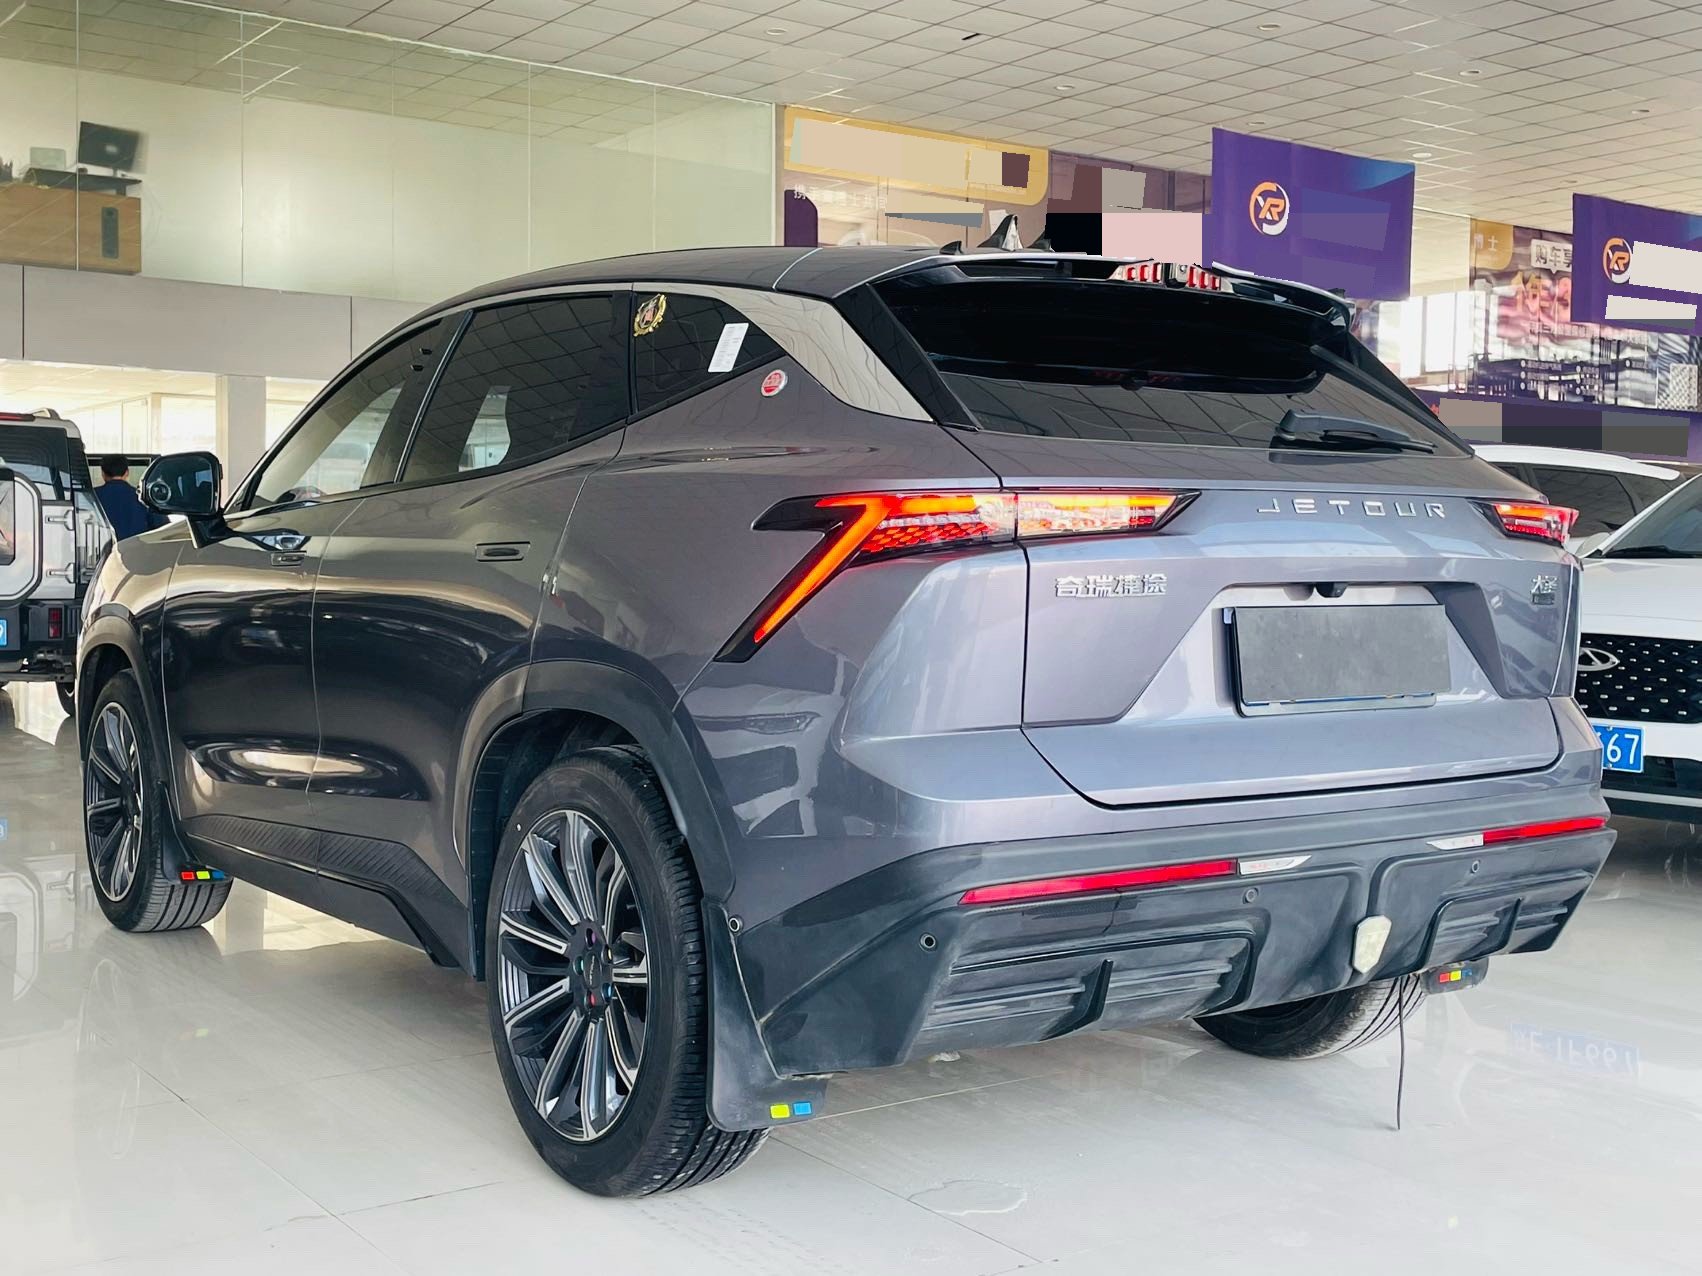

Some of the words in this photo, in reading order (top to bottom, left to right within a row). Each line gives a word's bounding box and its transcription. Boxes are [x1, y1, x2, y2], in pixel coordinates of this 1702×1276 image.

[1257, 498, 1446, 519] JETOUR
[1055, 573, 1168, 598] 奇瑞捷途
[1595, 731, 1640, 766] 67
